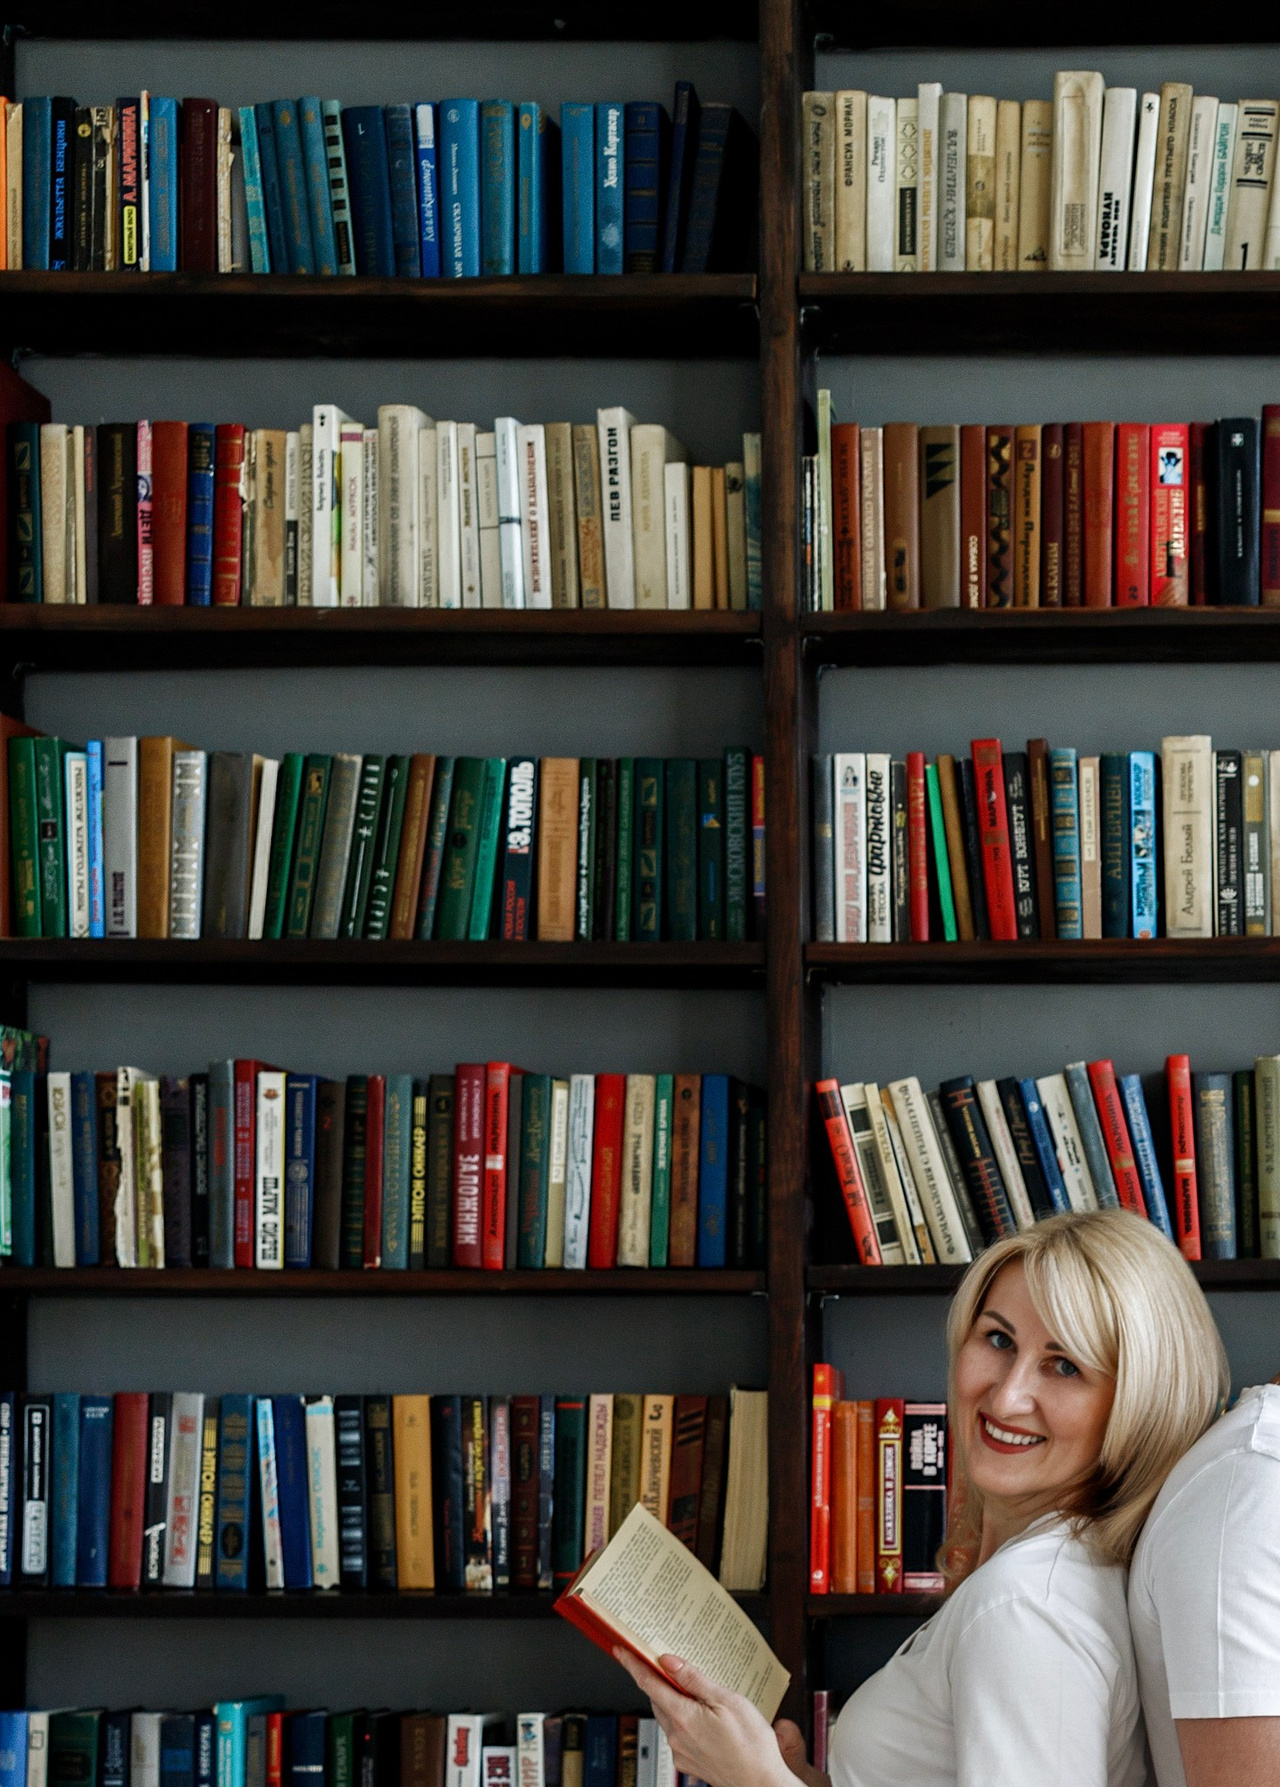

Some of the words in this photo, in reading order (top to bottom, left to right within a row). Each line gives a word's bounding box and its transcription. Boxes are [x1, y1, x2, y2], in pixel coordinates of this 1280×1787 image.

[55, 119, 67, 172] БЕНЦОНИ
[122, 105, 136, 187] МАРИНИНА
[603, 108, 621, 156] Кортасар
[1216, 122, 1230, 160] БАЙРОН
[603, 158, 619, 188] Хулио
[843, 142, 853, 187] ФРАНСУА
[607, 427, 619, 486] РАЗГОН
[141, 509, 153, 545] ДЕТИ
[609, 491, 621, 521] ЛЕВ
[1180, 823, 1193, 864] Белый
[1017, 864, 1031, 893] КУРТ
[1181, 868, 1195, 915] Андрей
[413, 1127, 426, 1177] СИНКЛЕР
[412, 1180, 426, 1222] ЭПТОН
[458, 1153, 480, 1245] ЗАЛОЖНИК
